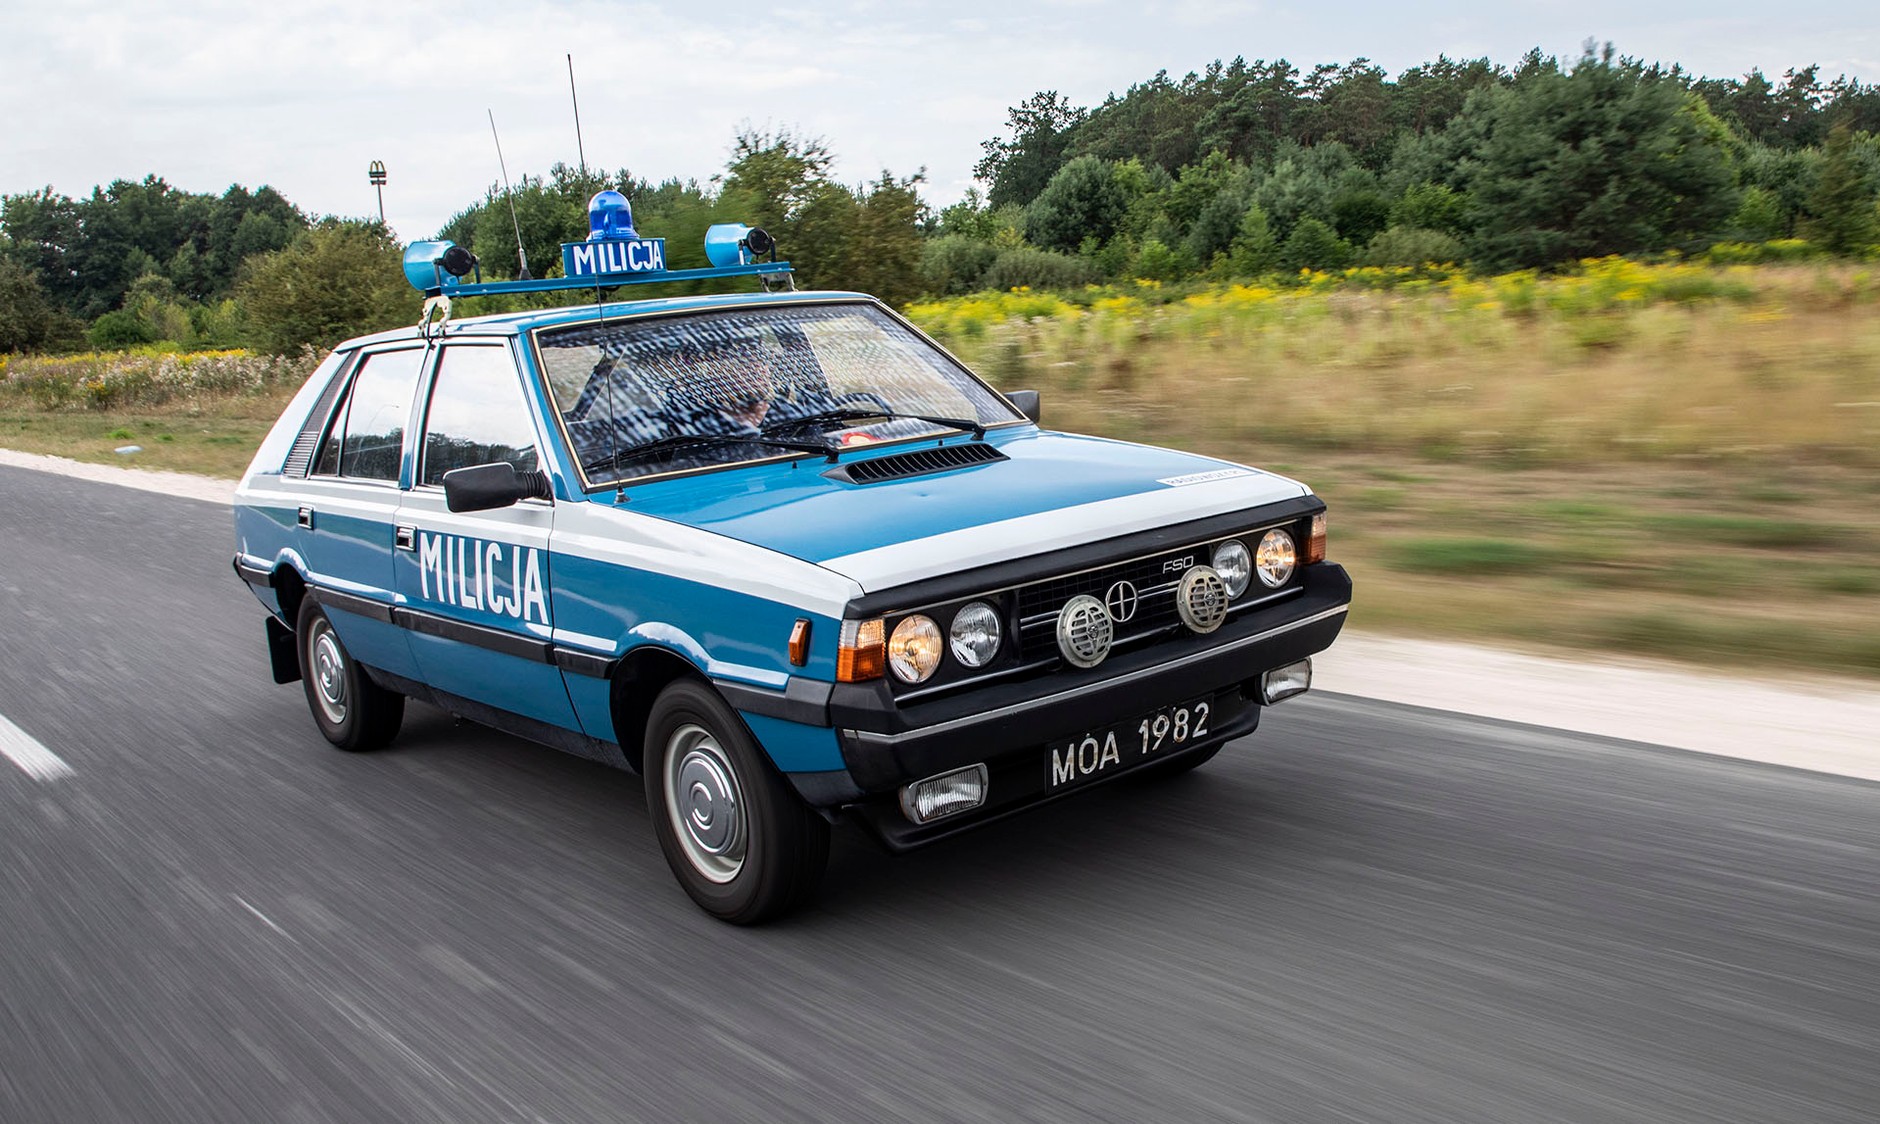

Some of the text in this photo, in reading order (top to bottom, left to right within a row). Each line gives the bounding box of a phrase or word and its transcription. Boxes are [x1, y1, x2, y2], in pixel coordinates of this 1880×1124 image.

[573, 241, 664, 275] MILICJA
[420, 532, 549, 625] MILICJA
[1162, 555, 1194, 574] FSO
[1052, 702, 1209, 786] MOA 1982
